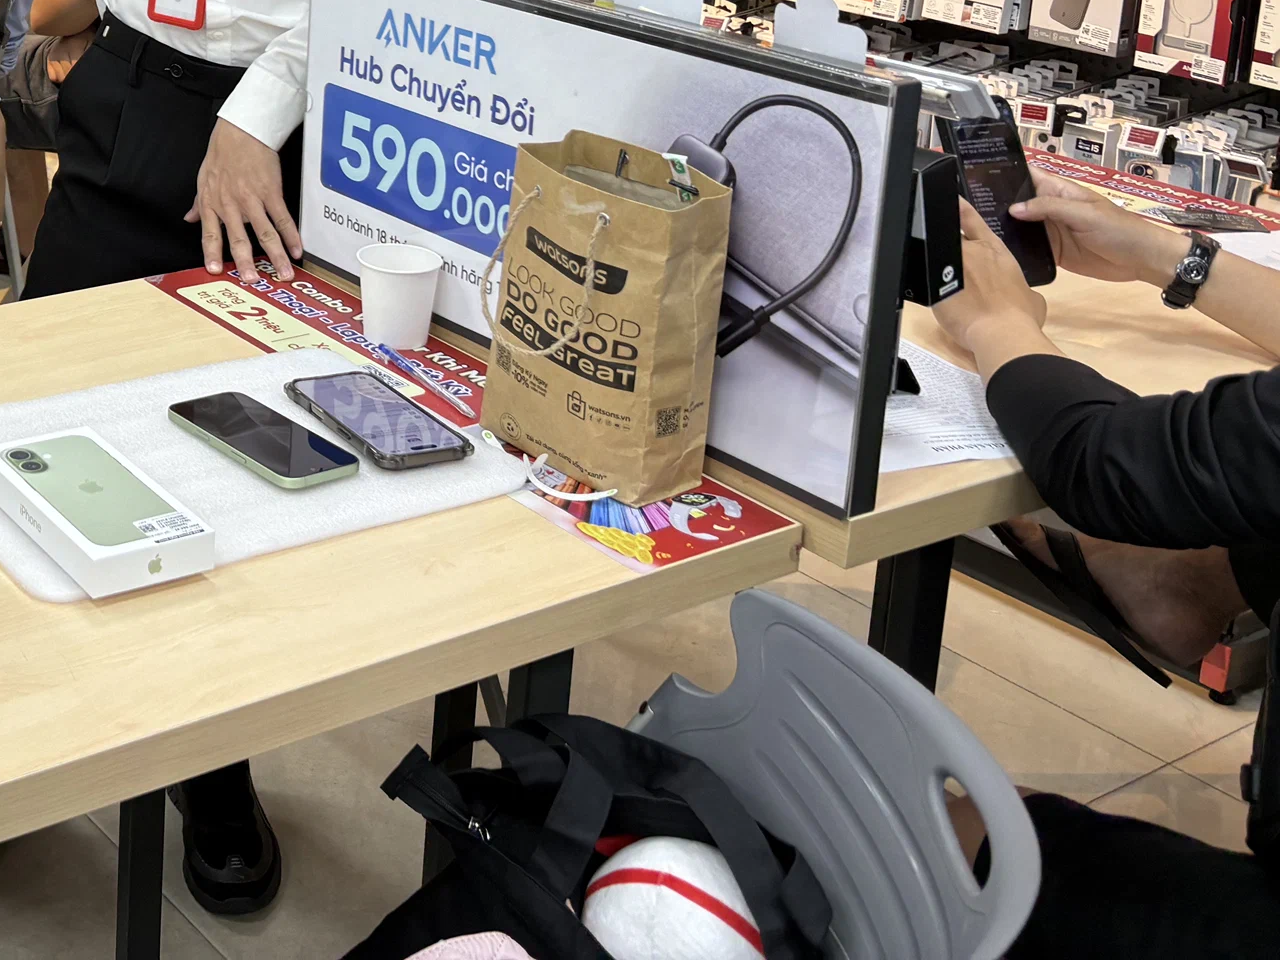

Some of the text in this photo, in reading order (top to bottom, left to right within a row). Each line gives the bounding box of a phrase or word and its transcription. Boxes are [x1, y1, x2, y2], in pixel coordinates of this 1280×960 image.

[376, 8, 497, 76] ANKER
[339, 45, 536, 136] Hub Chuyển Đổi
[454, 151, 488, 184] Giá
[1036, 152, 1239, 212] Combo Voucher Khi
[323, 204, 345, 227] Bảo
[346, 211, 374, 239] hành
[376, 227, 387, 245] 18
[533, 235, 608, 285] watsons
[217, 287, 246, 305] Tổng
[268, 287, 321, 320] Thoại
[290, 280, 353, 314] Combo
[506, 256, 641, 339] LOOK GOOD
[226, 306, 285, 334] 2 Triệu
[506, 278, 639, 361] DO GOOD
[425, 351, 466, 372] Khi
[588, 404, 631, 423] watsons.vn
[18, 502, 43, 535] iPhone
